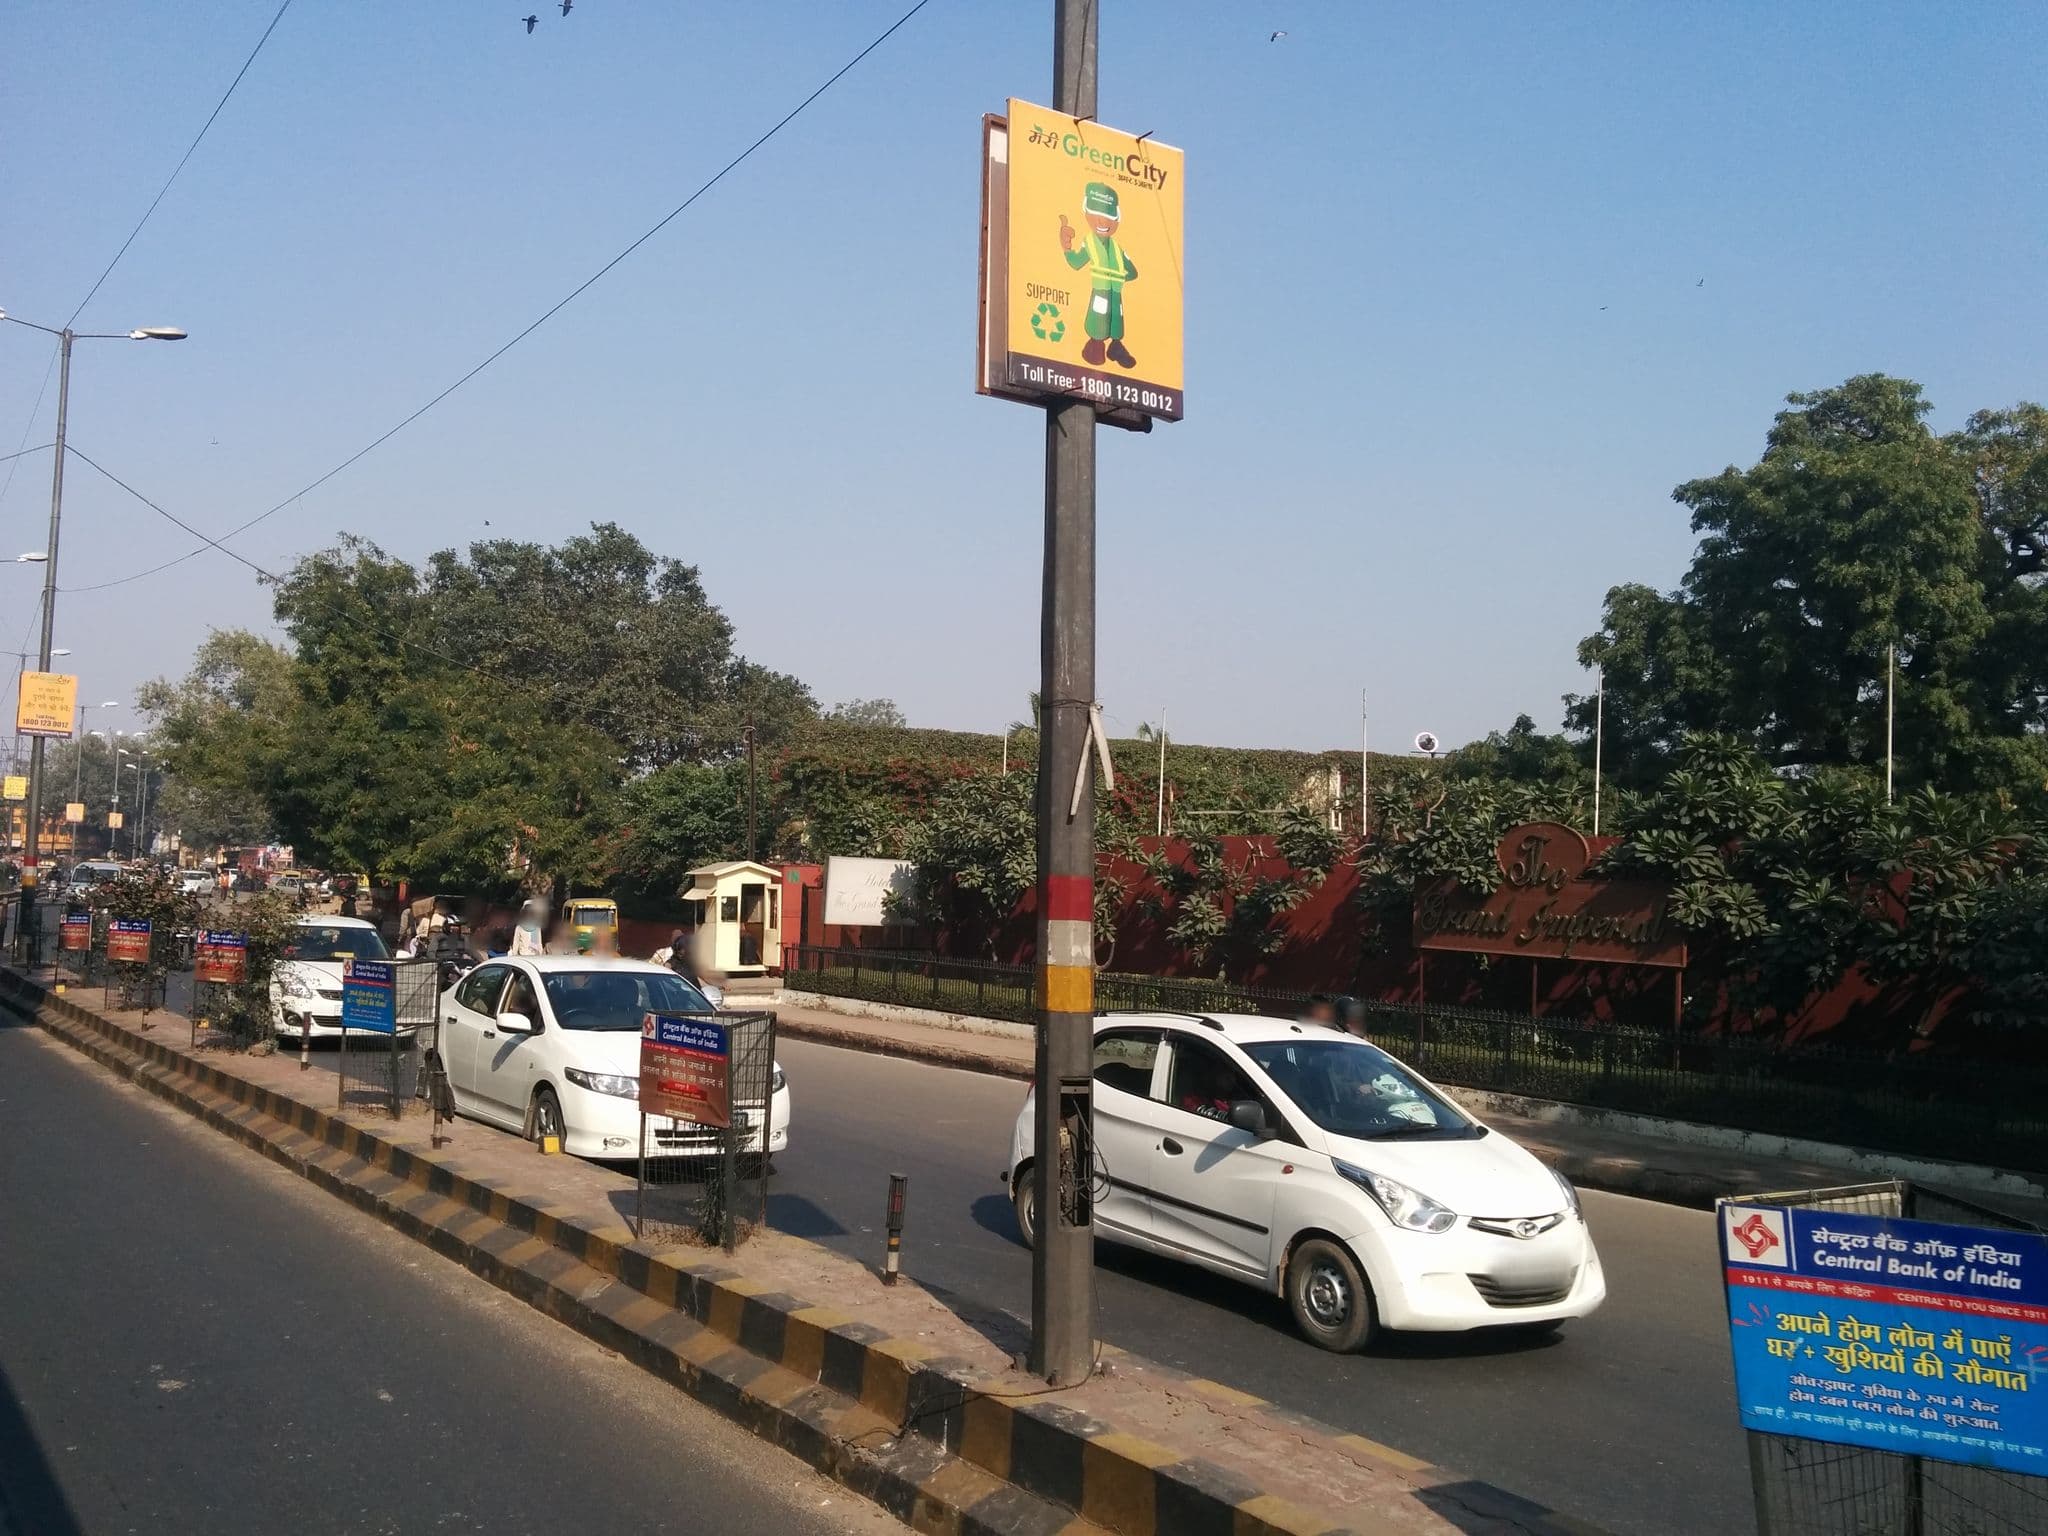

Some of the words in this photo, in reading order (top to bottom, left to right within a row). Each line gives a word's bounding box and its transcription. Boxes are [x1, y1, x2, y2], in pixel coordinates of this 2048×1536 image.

[1029, 124, 1059, 149] मेरी
[1026, 282, 1071, 306] SUPPORT
[1021, 363, 1044, 383] Toll
[1047, 369, 1076, 389] Free:
[1081, 376, 1112, 398] 1800
[1116, 384, 1138, 403] 123
[1142, 390, 1173, 412] 0012
[662, 1031, 682, 1042] Central
[683, 1036, 697, 1045] Bank
[697, 1038, 703, 1046] of
[704, 1040, 718, 1049] India
[1811, 1226, 1870, 1251] सेन्ट्रल
[1873, 1233, 1908, 1254] बैंक
[1963, 1244, 2023, 1266] इंडिया
[1742, 1275, 1769, 1285] 1911
[1773, 1276, 1782, 1287] से
[1813, 1250, 1881, 1272] Central
[1888, 1261, 1937, 1280] Bank
[1944, 1265, 1966, 1282] of
[1971, 1270, 2022, 1290] India
[1949, 1299, 1963, 1309] TO
[1965, 1302, 1987, 1312] YOU
[1988, 1304, 2021, 1317] SINCE
[2024, 1309, 2047, 1319] 1911
[1776, 1311, 1831, 1337] अपने
[1837, 1315, 1881, 1343] होम
[1887, 1322, 1935, 1350] लोन
[1942, 1328, 1966, 1355] में
[1767, 1338, 1796, 1360] घर
[1804, 1345, 1815, 1358] +
[1822, 1342, 1906, 1374] खुशियों
[1912, 1352, 1944, 1379] की
[1951, 1359, 2028, 1392] सौगात
[1789, 1389, 1815, 1403] होम
[1886, 1403, 1915, 1418] लोन
[1919, 1407, 1938, 1422] की
[1907, 1388, 1921, 1402] के
[1951, 1395, 1965, 1409] में
